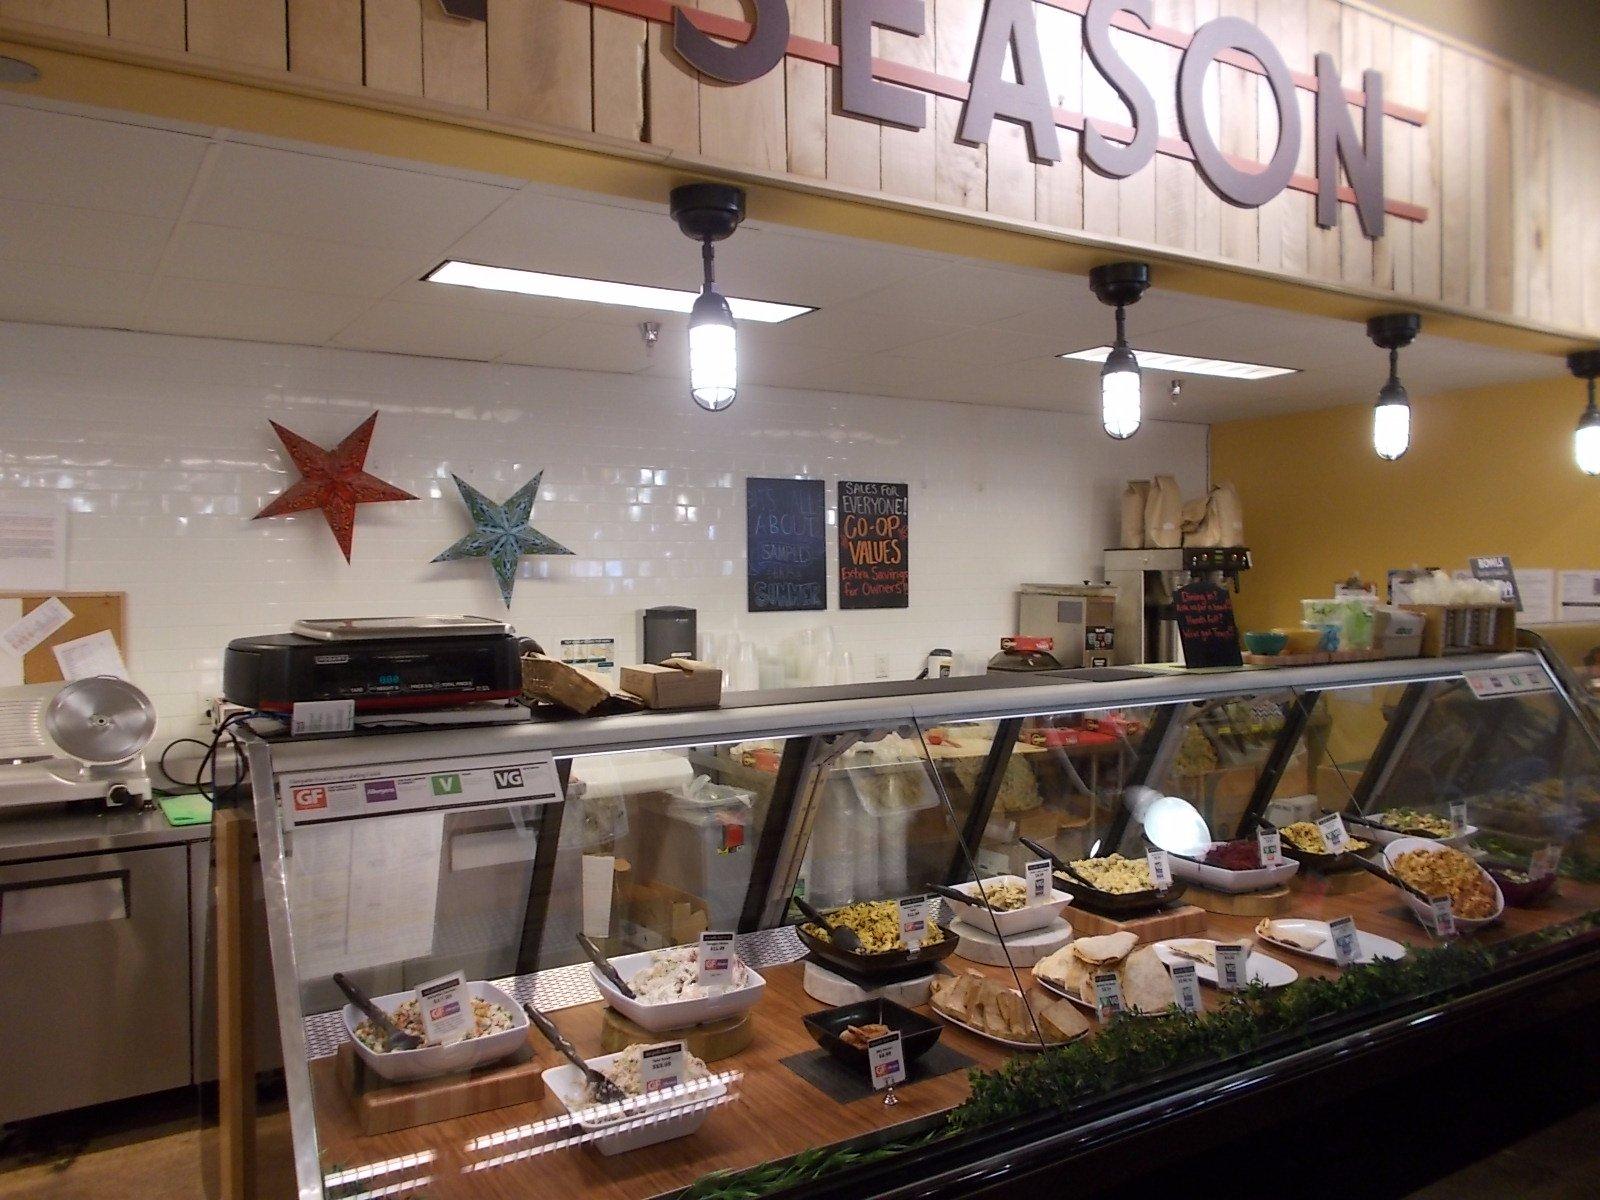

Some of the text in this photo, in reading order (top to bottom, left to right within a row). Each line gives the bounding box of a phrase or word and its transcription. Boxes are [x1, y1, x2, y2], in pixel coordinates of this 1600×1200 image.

[845, 482, 899, 496] SALES FOR
[842, 495, 908, 515] EVERYONE!
[844, 515, 901, 539] CO-OP
[848, 539, 902, 565] VALUES
[438, 777, 453, 792] V
[495, 771, 522, 787] VG
[296, 787, 324, 806] GF
